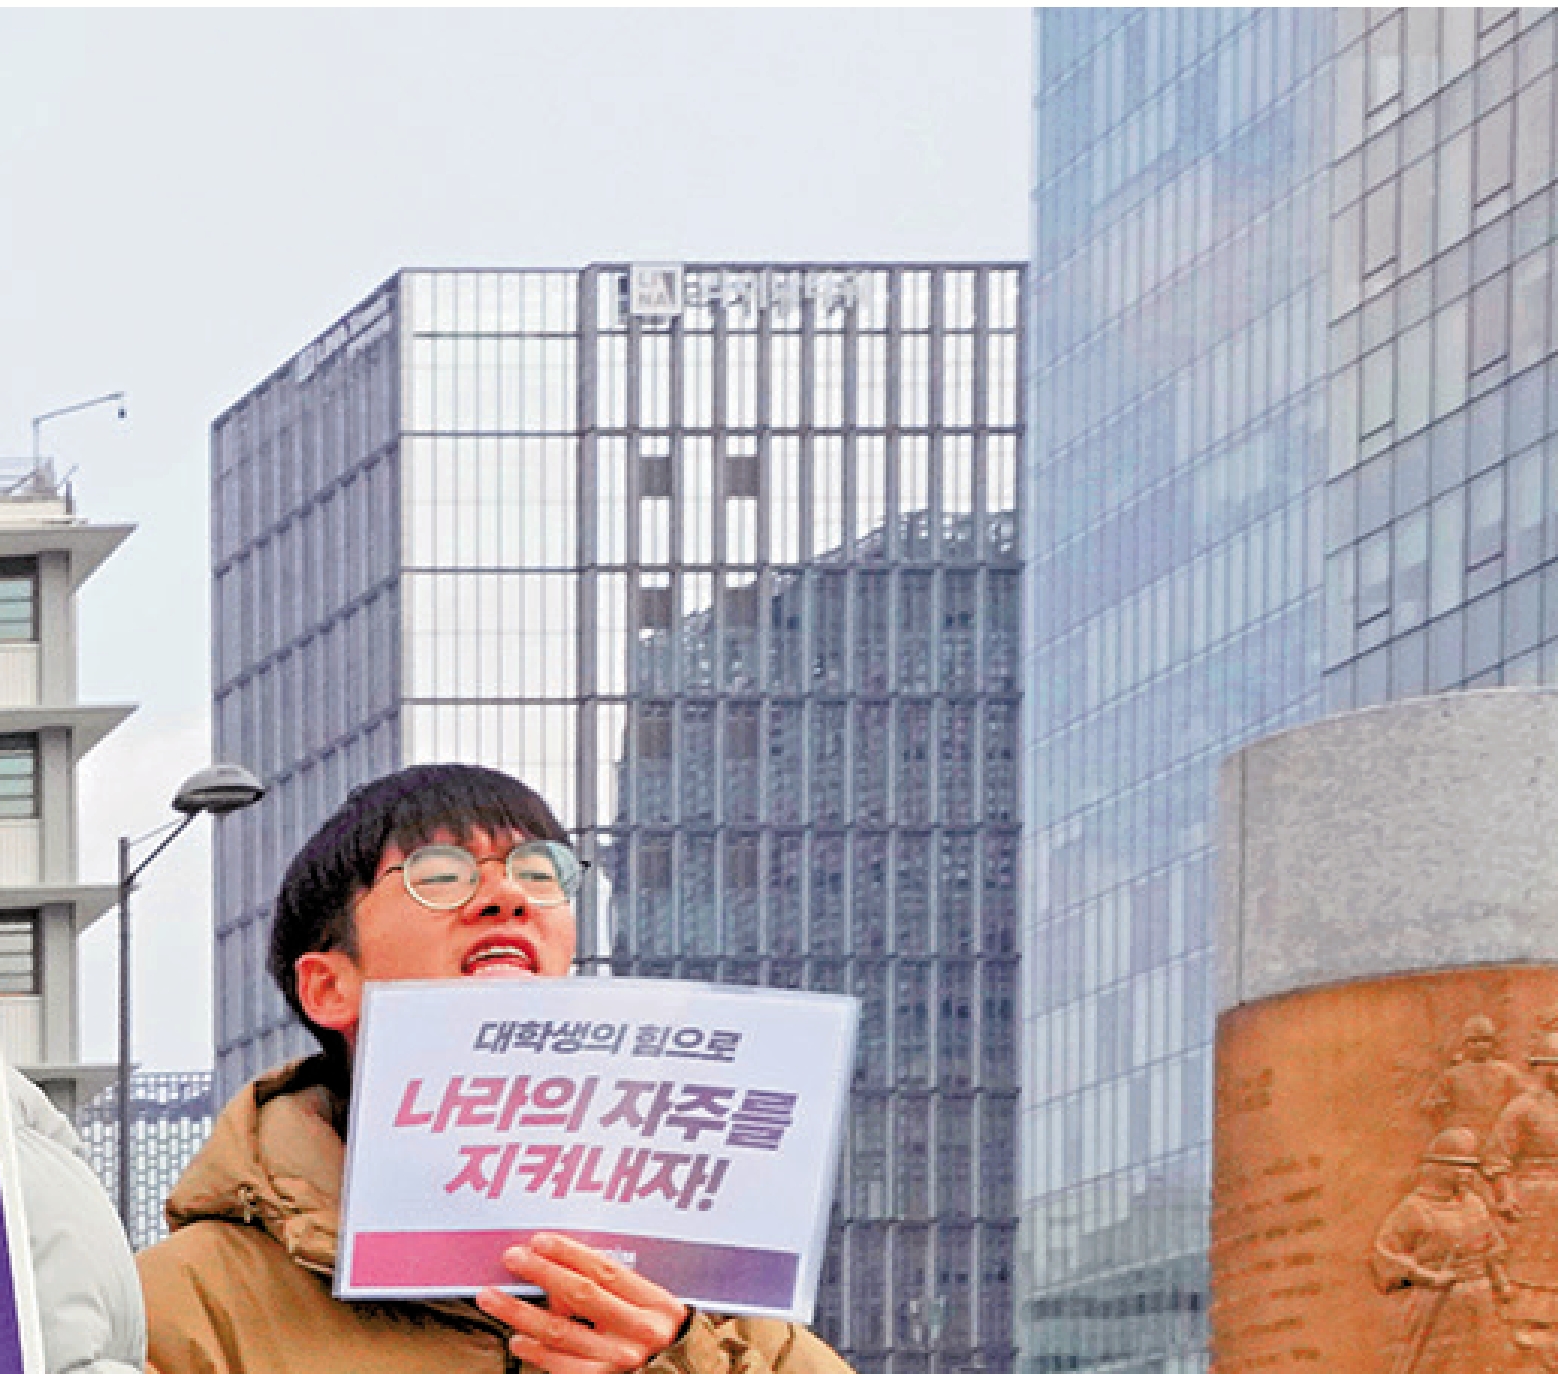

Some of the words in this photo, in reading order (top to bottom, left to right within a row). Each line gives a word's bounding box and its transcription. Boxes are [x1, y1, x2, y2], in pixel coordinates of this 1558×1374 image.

[472, 1020, 626, 1055] 대학생의
[625, 1024, 742, 1064] 힘으로
[394, 1075, 598, 1134] 나라의
[600, 1078, 798, 1152] 자주를
[444, 1143, 730, 1212] 지켜내자!
